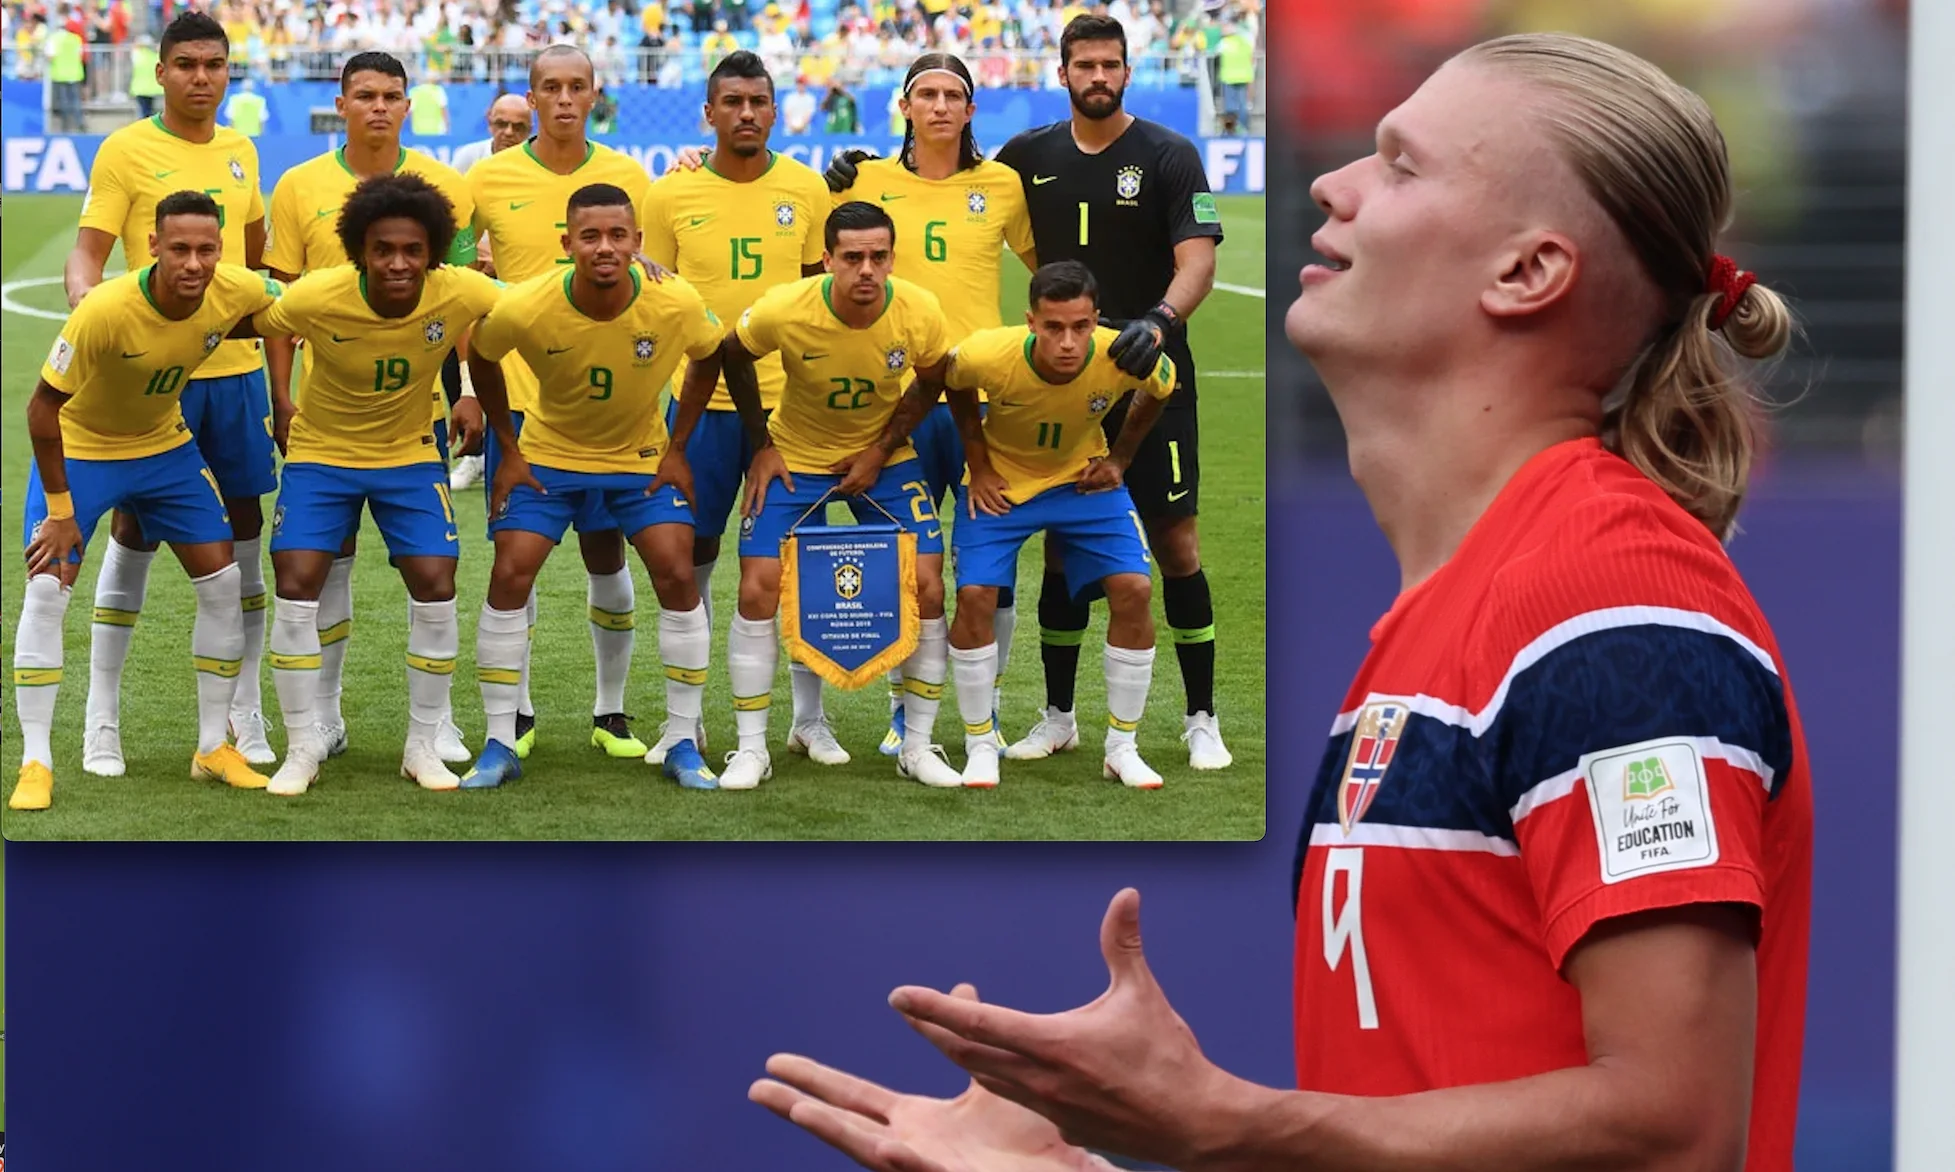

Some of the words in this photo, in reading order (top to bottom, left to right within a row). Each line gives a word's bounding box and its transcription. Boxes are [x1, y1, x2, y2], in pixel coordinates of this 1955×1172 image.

[1207, 139, 1264, 191] FI
[1079, 202, 1089, 245] 1
[730, 238, 762, 280] 15
[925, 221, 947, 262] 6
[143, 366, 184, 396] 10
[374, 357, 410, 392] 19
[588, 366, 613, 401] 9
[827, 377, 875, 410] 22
[1038, 422, 1062, 449] 11
[1168, 441, 1181, 484] 1
[200, 467, 225, 507] 1
[835, 602, 864, 610] BRASIL
[1623, 803, 1658, 829] Unite
[1658, 796, 1680, 820] For
[1617, 820, 1695, 853] EDUCATION
[1322, 847, 1380, 1030] 9
